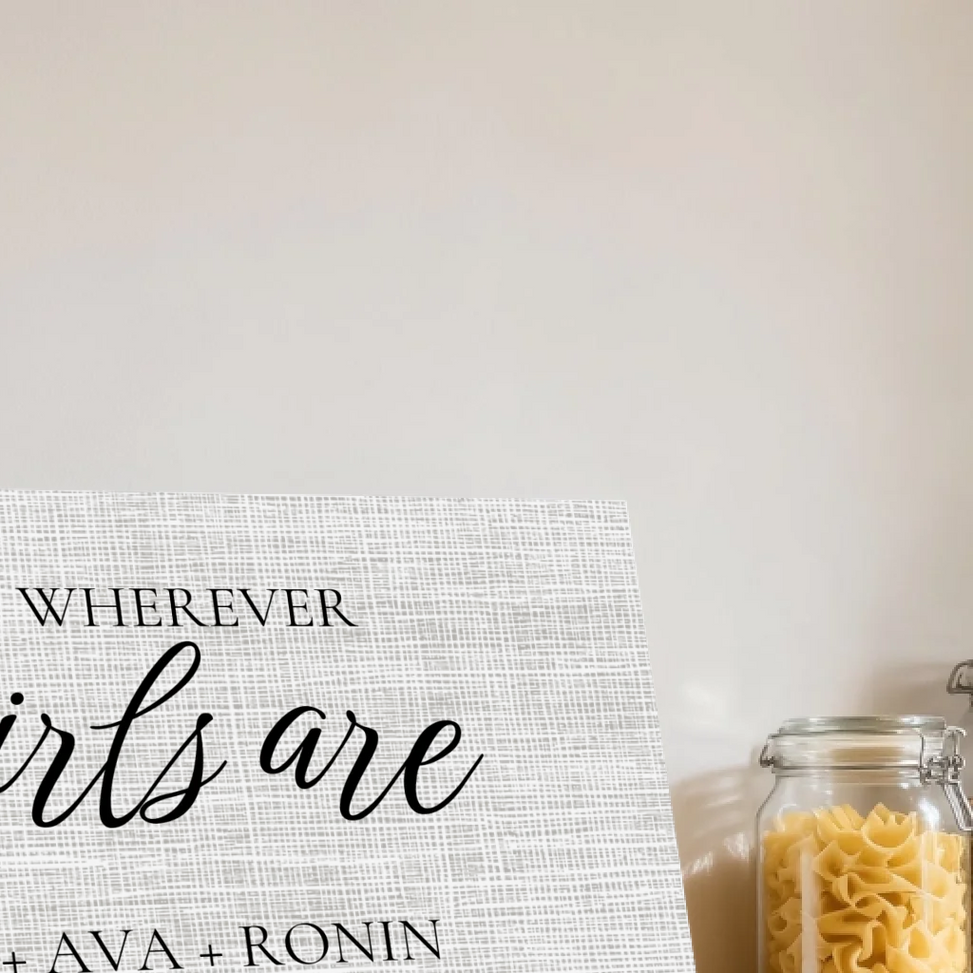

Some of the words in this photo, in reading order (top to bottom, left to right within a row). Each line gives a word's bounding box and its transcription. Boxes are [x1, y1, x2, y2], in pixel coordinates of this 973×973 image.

[13, 586, 359, 628] WHEREVER
[258, 705, 485, 822] are
[199, 944, 223, 967] +
[239, 919, 443, 968] RONIN
